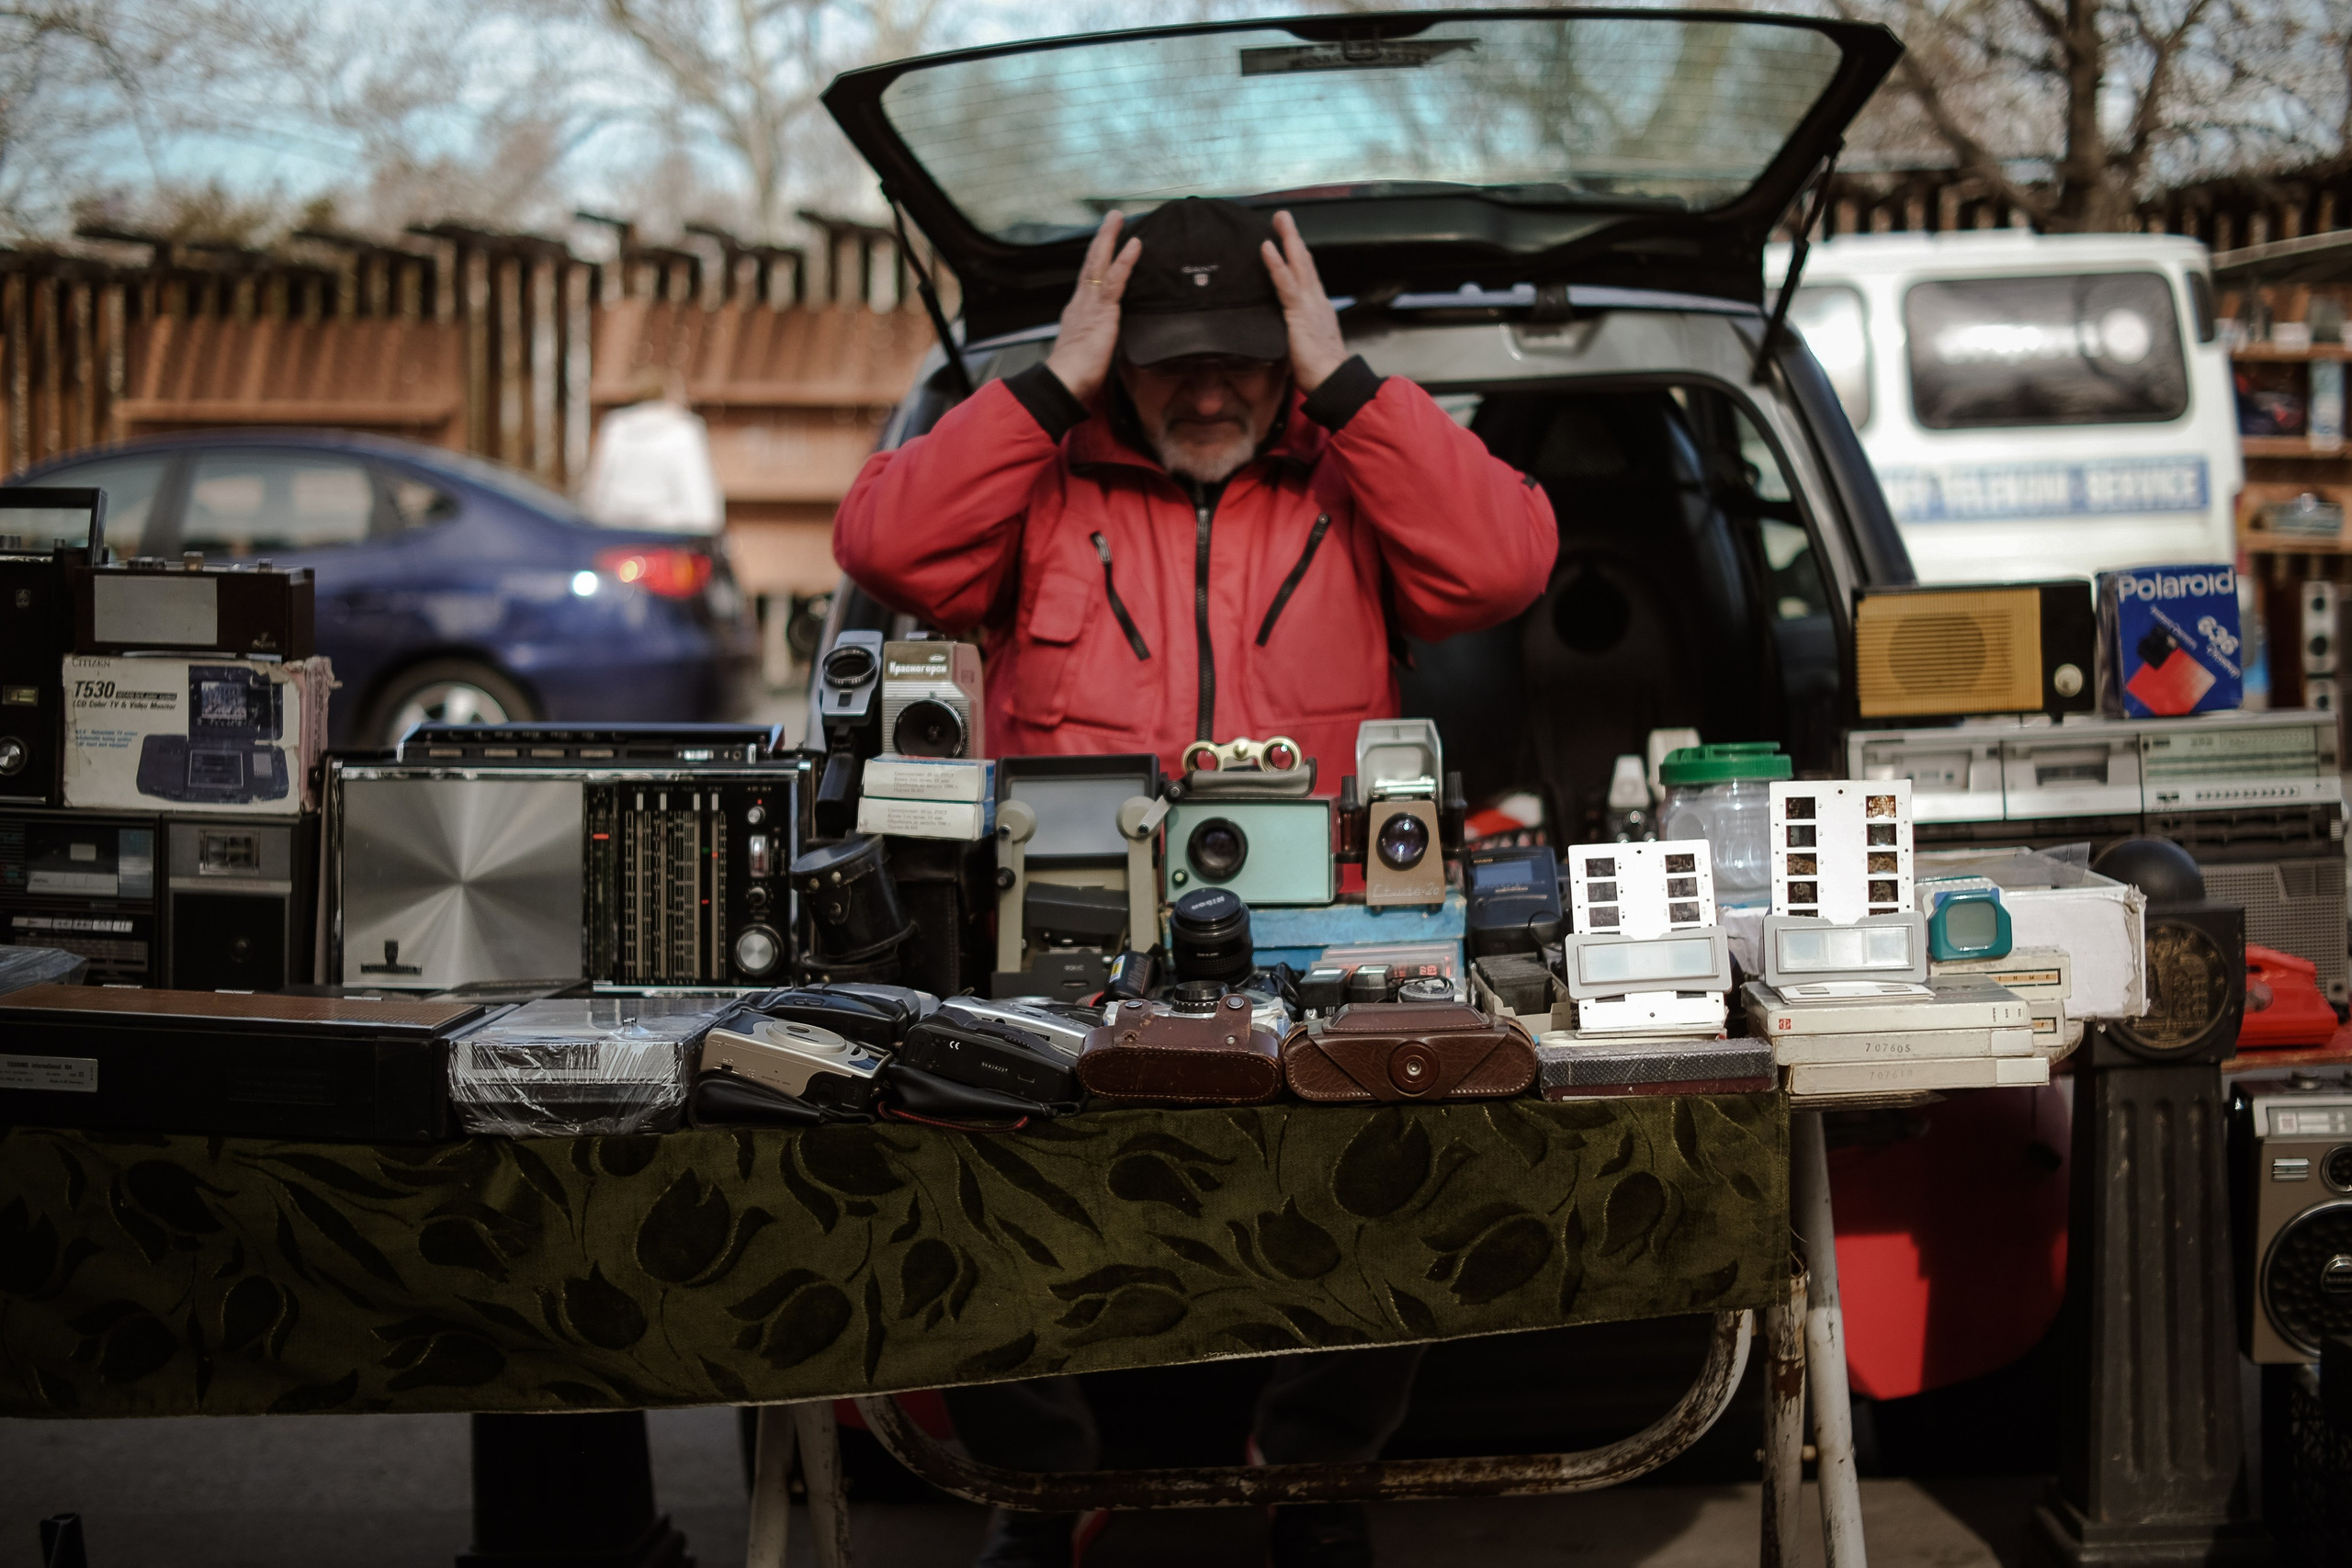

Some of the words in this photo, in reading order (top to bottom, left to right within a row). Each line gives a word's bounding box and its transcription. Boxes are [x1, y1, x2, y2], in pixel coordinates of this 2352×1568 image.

[2119, 567, 2234, 604] Polaroid
[2197, 615, 2239, 656] 636
[73, 658, 110, 668] CITIZEN
[888, 660, 947, 677] Красногорск
[74, 680, 116, 699] T530
[89, 700, 107, 709] Color
[110, 701, 119, 709] TV
[130, 701, 148, 710] Video
[149, 701, 176, 711] Monitor
[1191, 895, 1226, 910] Nikon
[949, 1040, 961, 1050] CE
